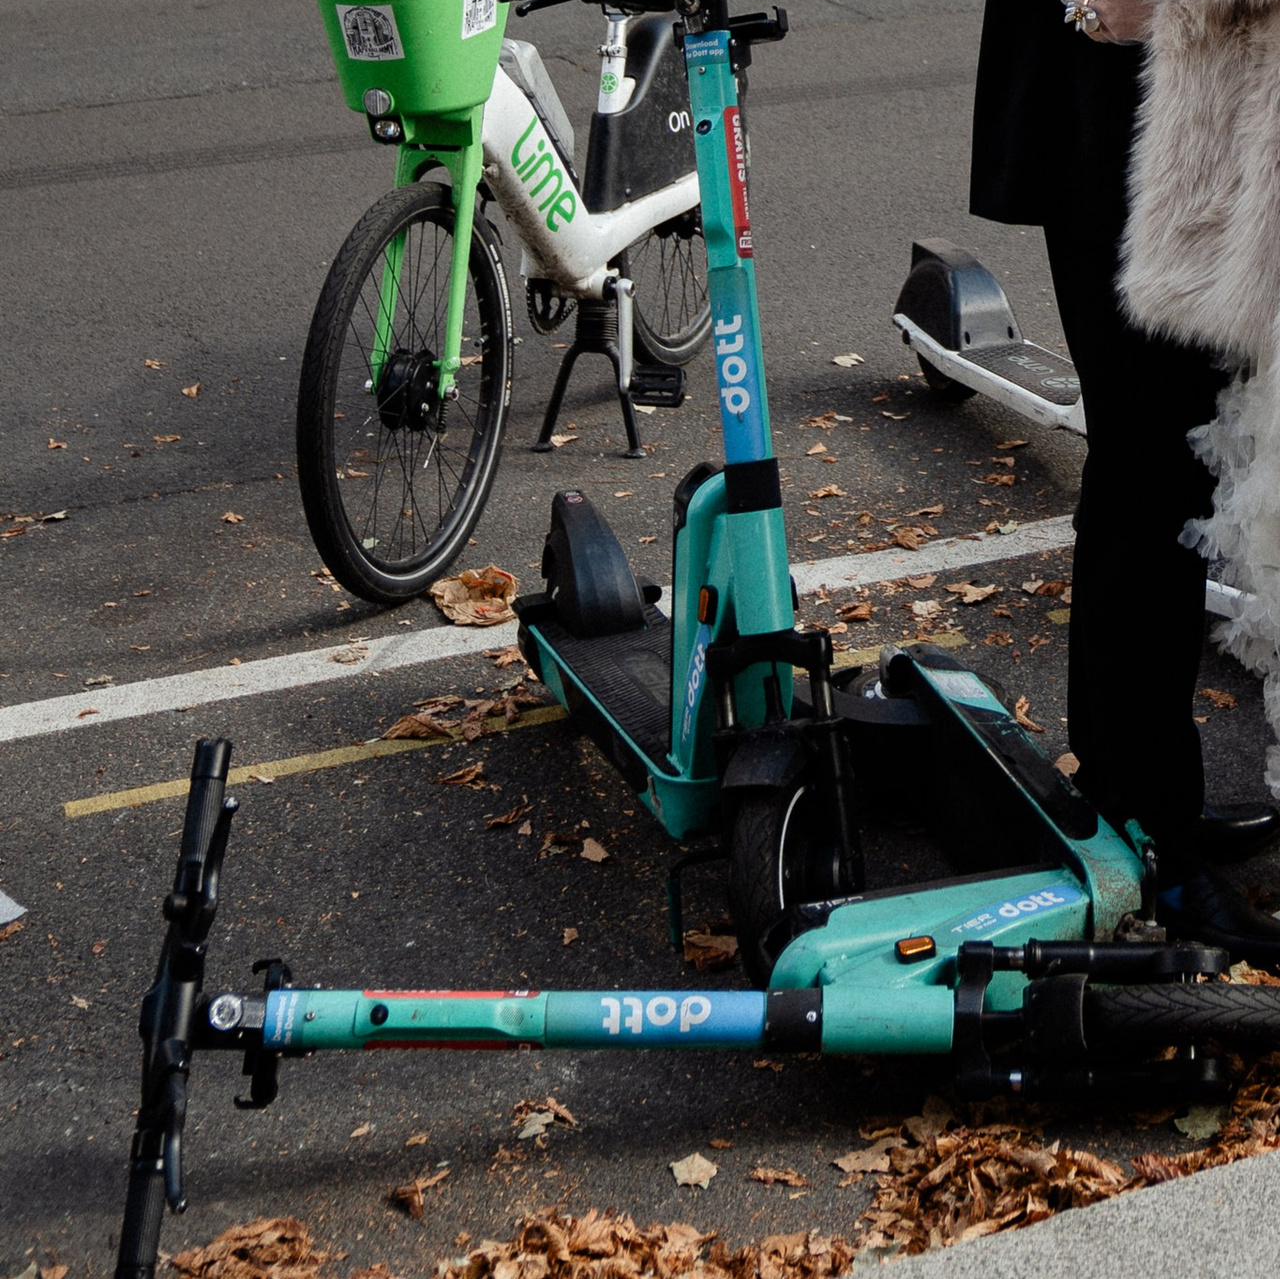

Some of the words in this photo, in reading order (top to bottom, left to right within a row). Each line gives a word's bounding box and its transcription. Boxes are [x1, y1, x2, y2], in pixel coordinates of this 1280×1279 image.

[709, 47, 724, 57] app
[668, 110, 691, 133] On
[715, 314, 751, 415] dott
[688, 642, 705, 708] dott
[998, 891, 1066, 918] dott
[601, 995, 712, 1035] dott
